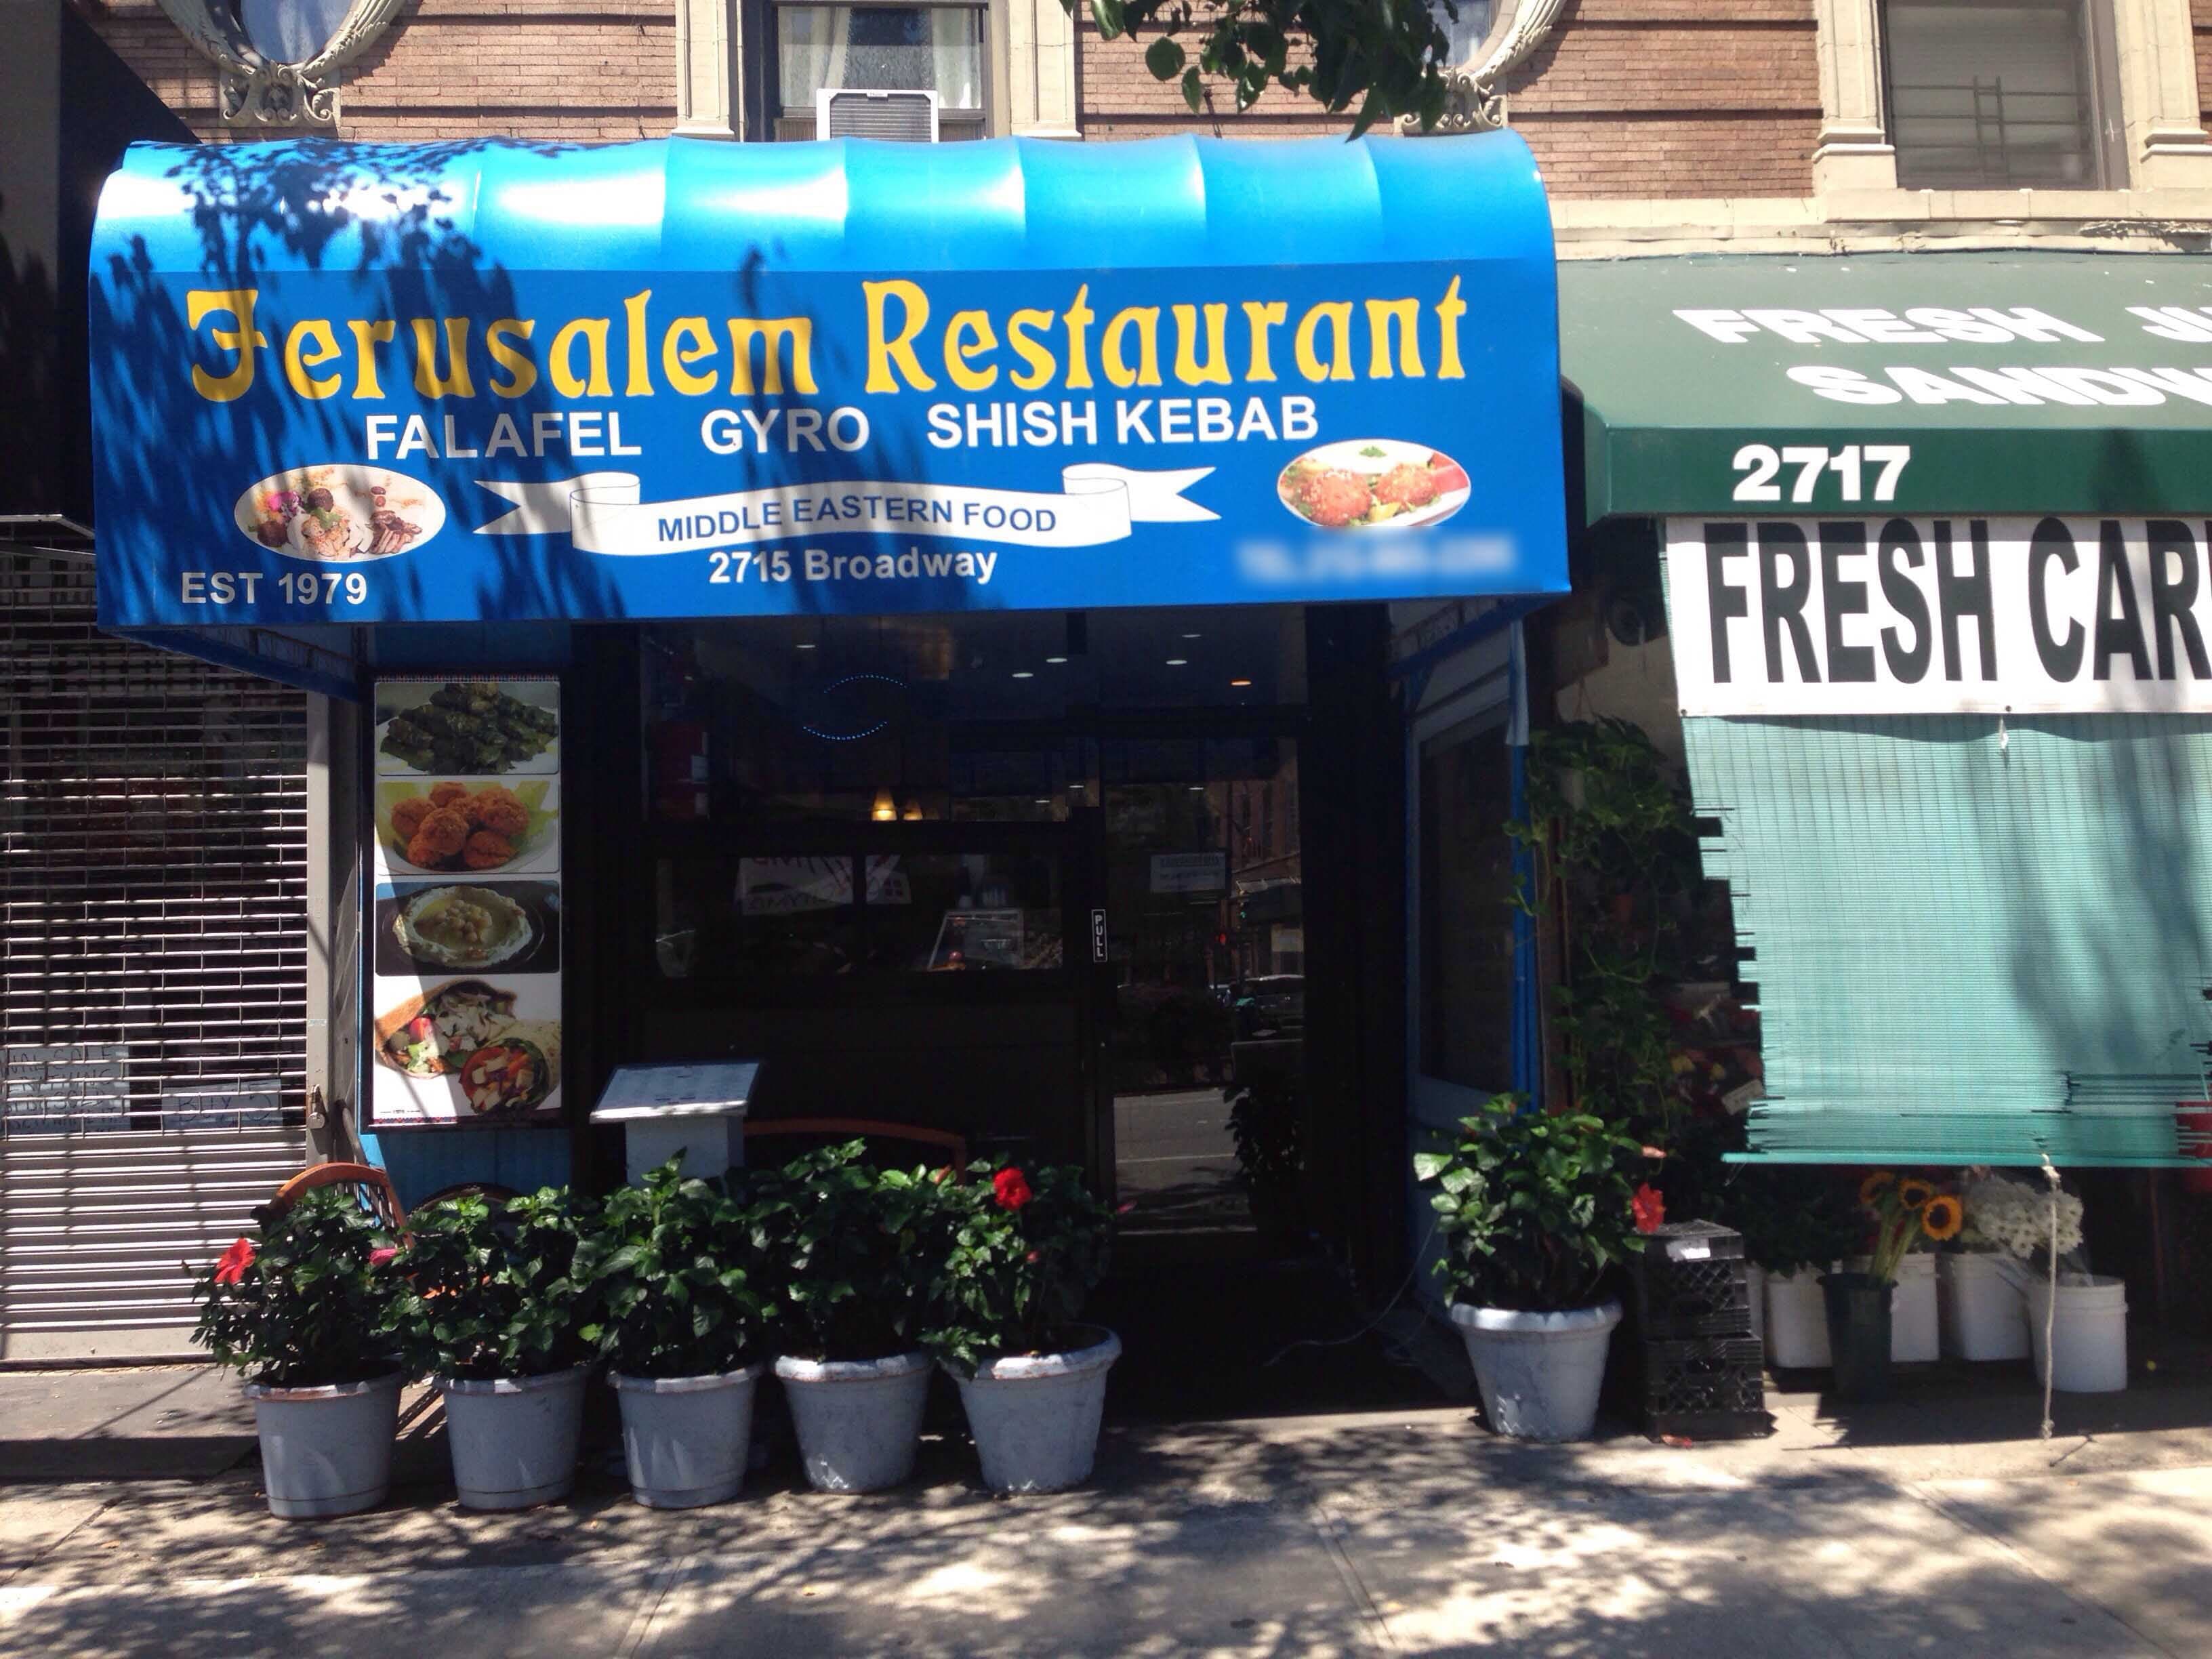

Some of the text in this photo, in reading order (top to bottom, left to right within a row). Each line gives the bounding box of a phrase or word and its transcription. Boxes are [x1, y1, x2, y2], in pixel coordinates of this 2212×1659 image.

[186, 275, 1467, 401] Jerusalem Restaurant
[1672, 307, 2106, 343] FRESH
[366, 395, 1319, 460] FALAFEL GYRO SHISH KEBAB
[1732, 444, 1910, 503] 2717
[657, 495, 1057, 541] MIDDLE EASTERN FOOD
[182, 571, 367, 605] EST 1979
[708, 547, 998, 585] 2715 Broadway
[1704, 517, 2212, 684] FRESH CAR
[1094, 915, 1103, 957] PULL
